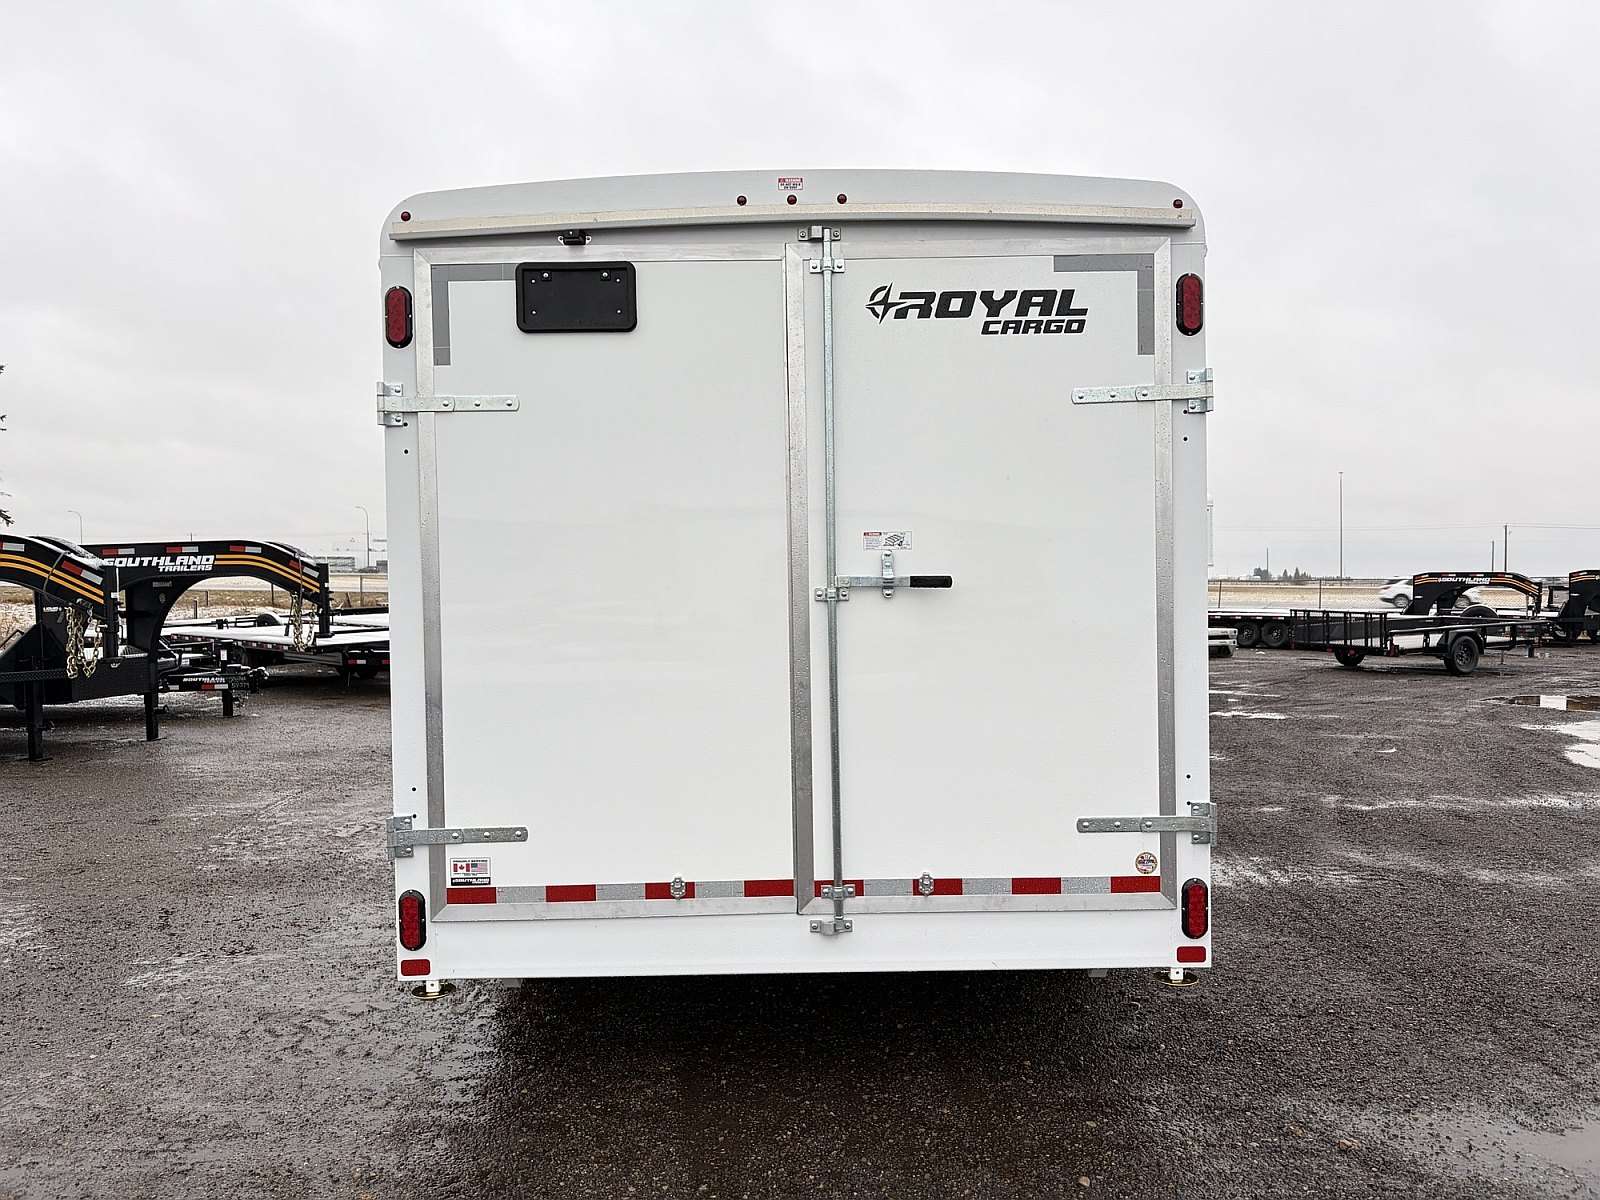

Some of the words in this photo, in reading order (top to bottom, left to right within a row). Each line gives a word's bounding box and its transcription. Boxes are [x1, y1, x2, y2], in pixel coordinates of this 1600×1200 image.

[893, 289, 1088, 319] ROYAL
[981, 319, 1086, 335] CARGO
[102, 555, 215, 567] SOUTHLAND
[158, 564, 213, 572] TRAILERS
